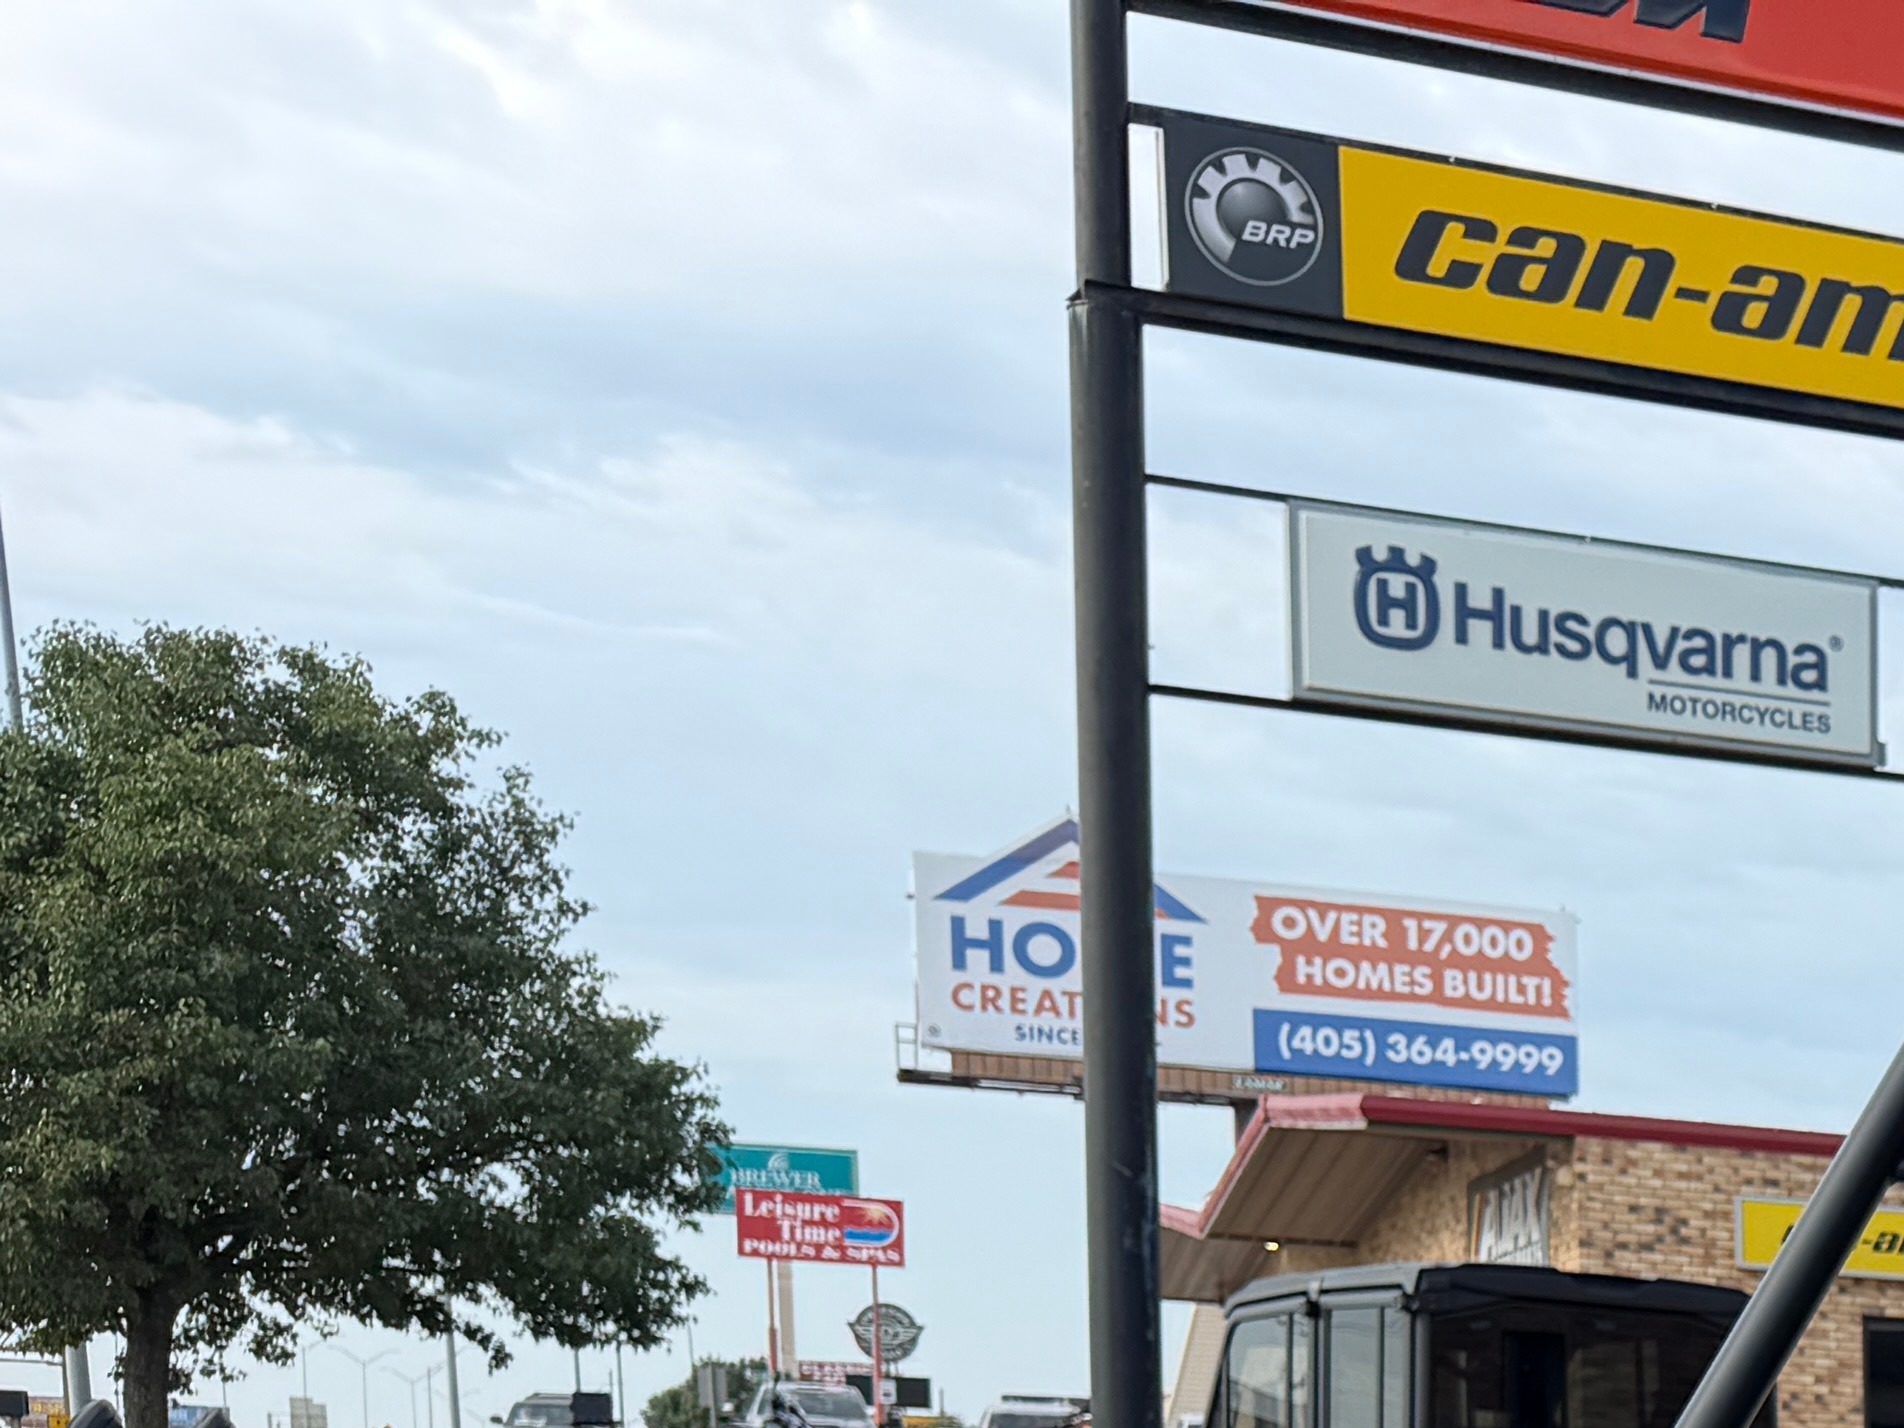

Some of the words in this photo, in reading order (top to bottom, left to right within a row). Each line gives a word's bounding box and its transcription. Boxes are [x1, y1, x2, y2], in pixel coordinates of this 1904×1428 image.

[1242, 219, 1316, 249] BRP
[1453, 580, 1830, 694] Husqvarna
[1646, 690, 1833, 735] MOTORCYCLES
[949, 914, 1196, 990] HOE
[1270, 905, 1389, 949] OVER
[1401, 917, 1534, 962] 17,000
[1295, 955, 1435, 997] HOMES
[1442, 967, 1553, 1007] BUILT!
[1014, 1023, 1080, 1046] SINCE
[1277, 1021, 1377, 1068] (405)
[1385, 1032, 1564, 1077] 364-9999
[731, 1167, 822, 1188] BREWER
[743, 1191, 841, 1223] Leisure
[743, 1237, 817, 1257] POOLS
[821, 1244, 842, 1260] &
[846, 1245, 901, 1263] SPAS
[777, 1218, 842, 1245] Time
